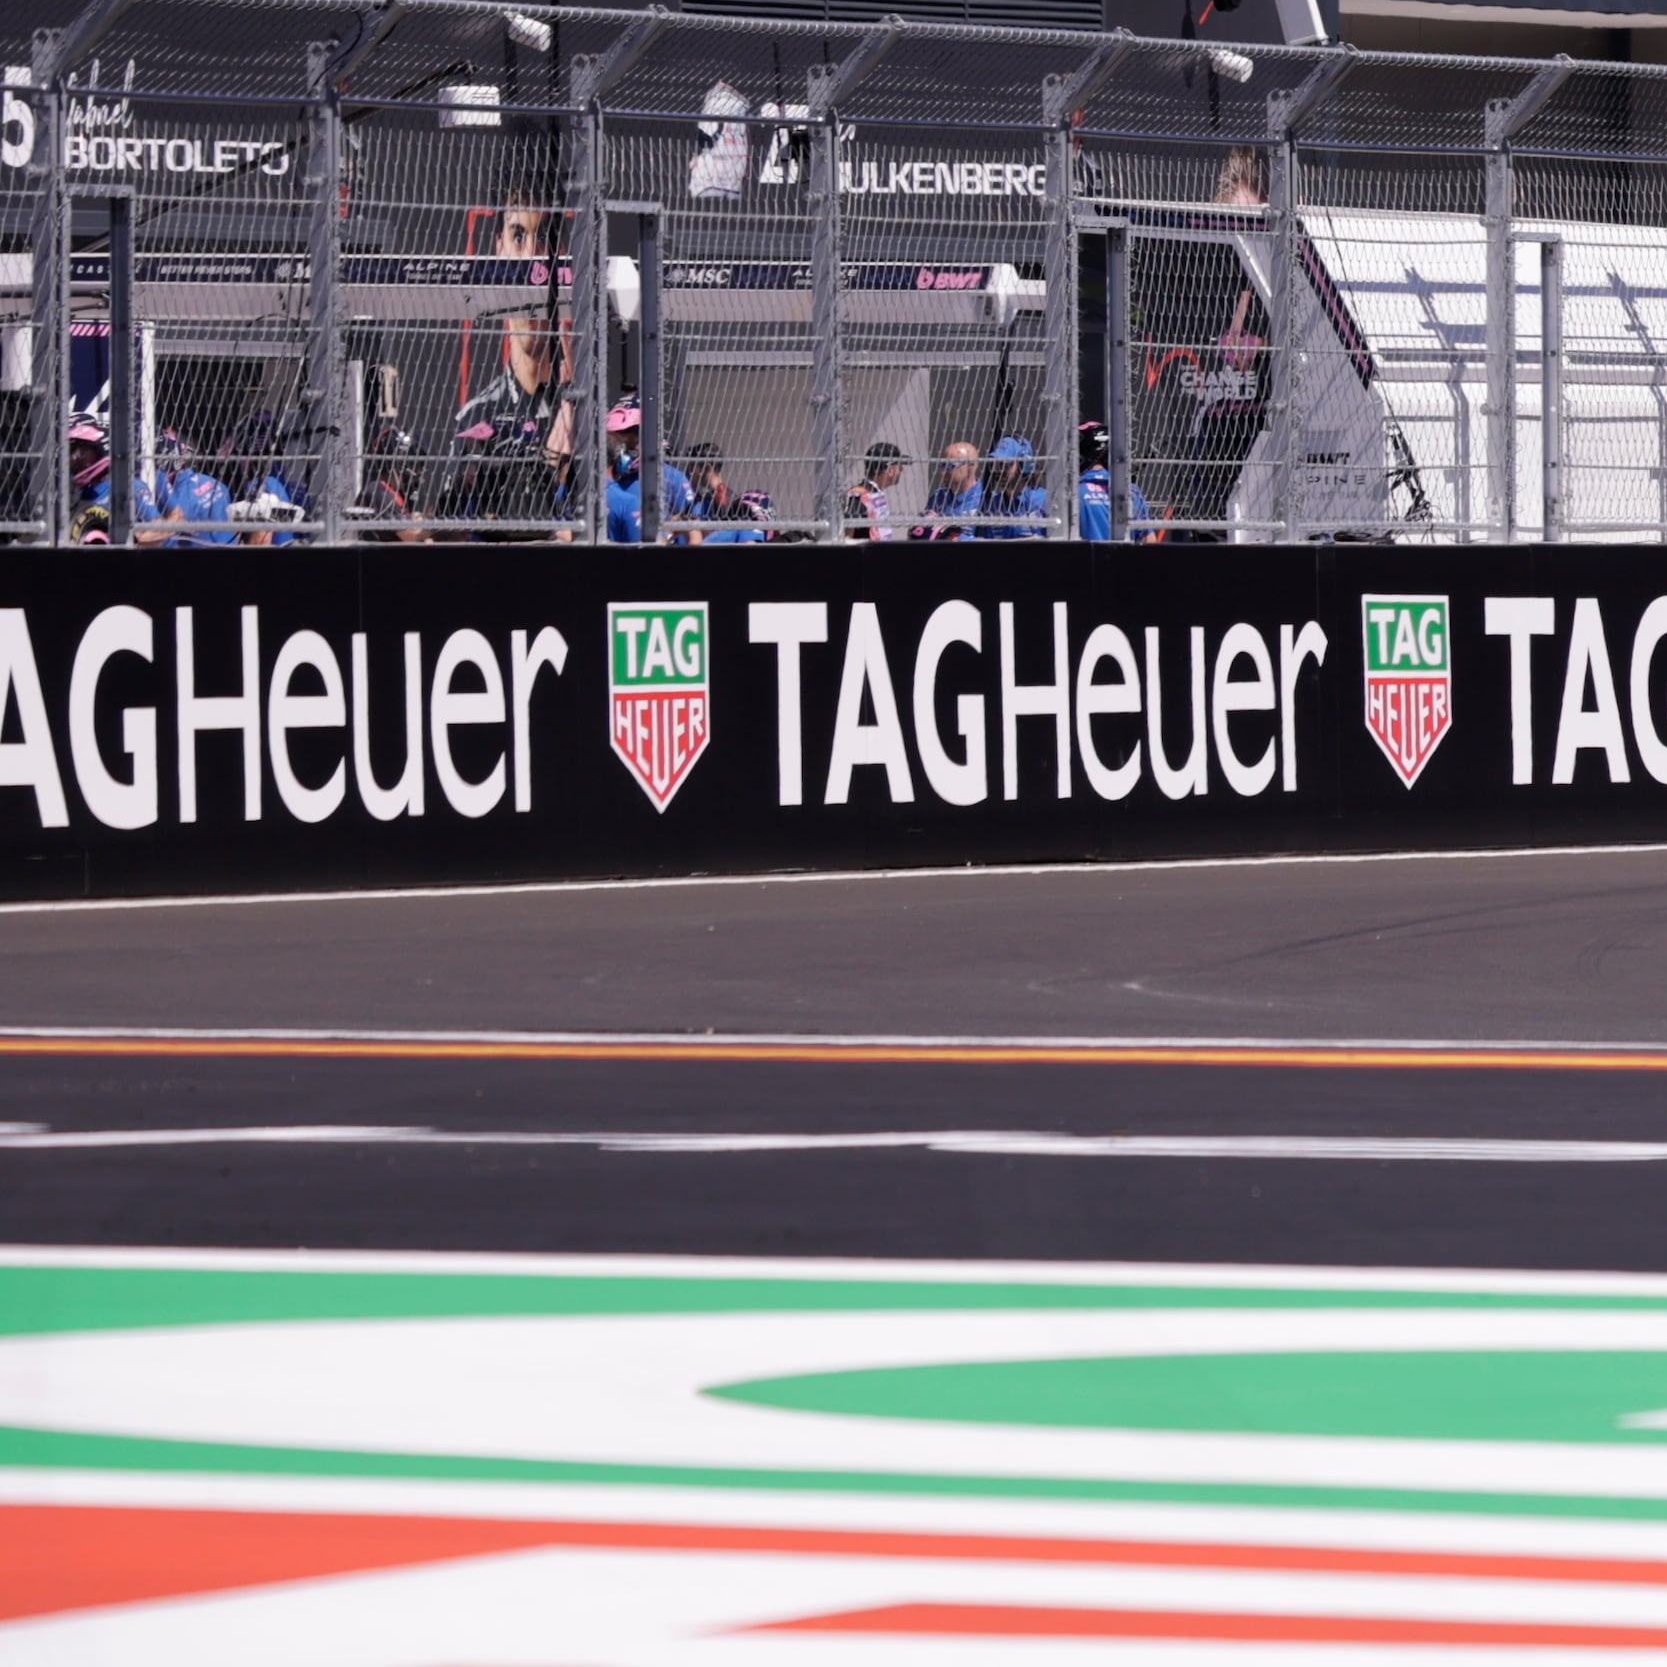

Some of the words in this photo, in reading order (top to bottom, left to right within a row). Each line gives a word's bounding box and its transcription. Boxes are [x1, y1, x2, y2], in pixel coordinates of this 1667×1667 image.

[65, 136, 290, 176] BORTOLETO
[403, 262, 471, 271] ALPINE
[687, 268, 731, 284] MSC
[935, 272, 982, 290] BWT
[616, 610, 702, 679] TAG
[1369, 607, 1443, 666] TAG
[748, 599, 1328, 806] TAGHeuer
[1368, 683, 1448, 776] HEUER
[614, 695, 706, 795] HEUER
